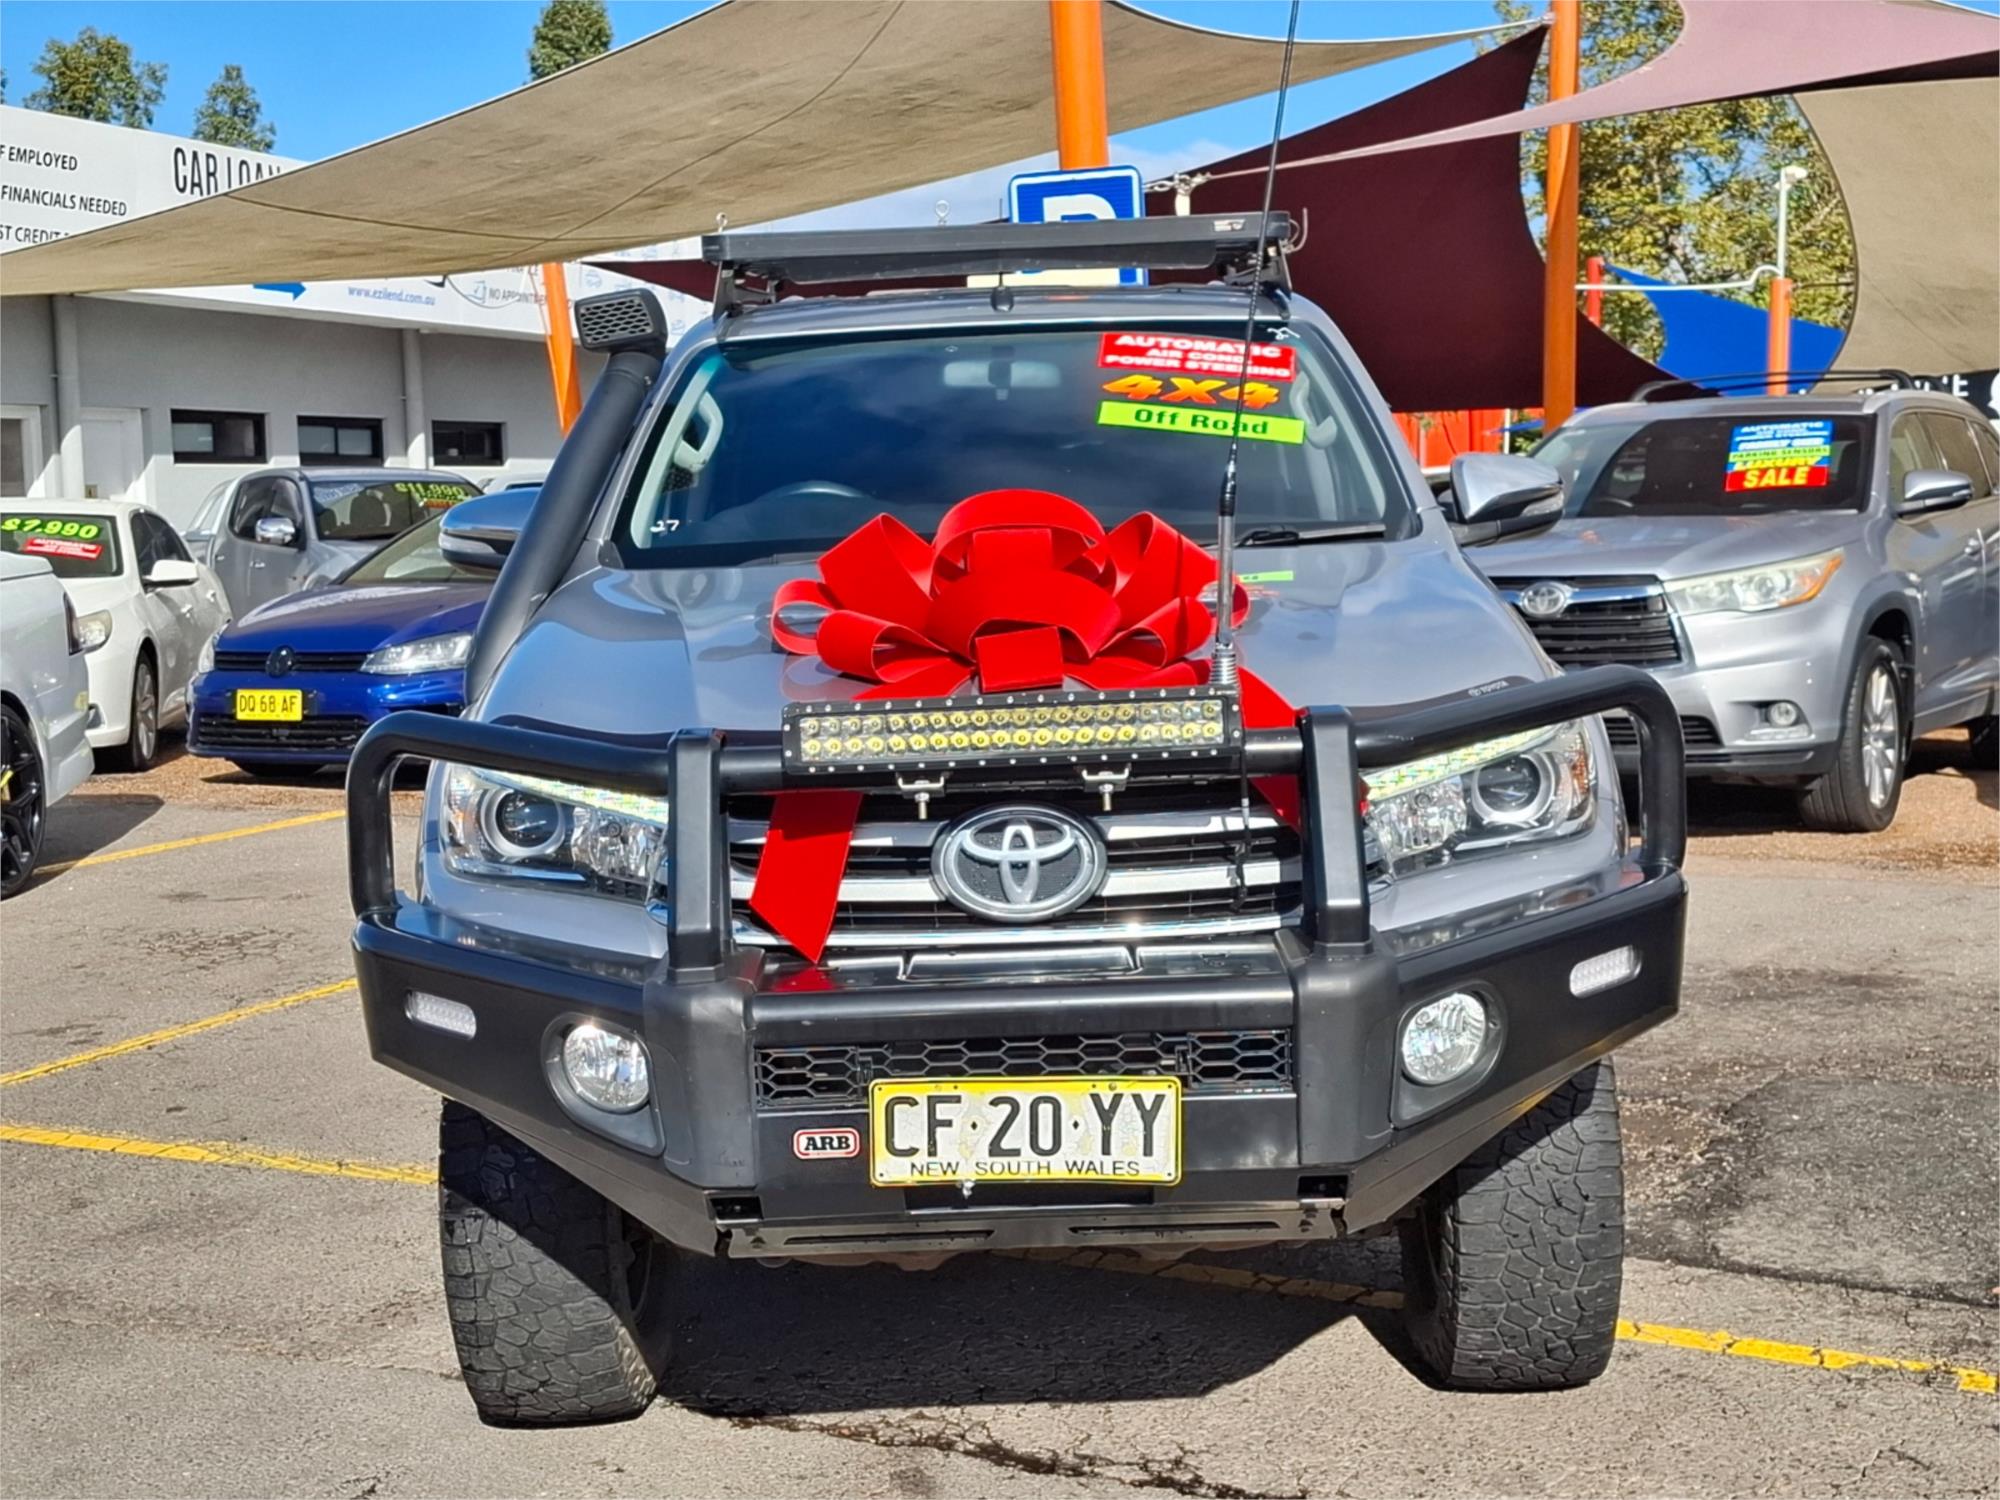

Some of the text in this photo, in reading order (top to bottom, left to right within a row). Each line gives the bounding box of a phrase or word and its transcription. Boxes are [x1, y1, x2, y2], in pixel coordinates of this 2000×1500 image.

[8, 146, 78, 171] EMPLOYED
[174, 147, 219, 197] CAR
[1, 185, 128, 216] FINANCIALS NEEDED
[1114, 335, 1282, 358] AUTOMATIC
[1146, 348, 1183, 359] AIR
[1105, 354, 1181, 369] POWER
[1102, 374, 1280, 410] 4X4
[1134, 408, 1268, 435] Off Road
[1742, 465, 1811, 489] SALE
[281, 695, 298, 713] AF
[884, 1093, 1166, 1158] CF 20 YY
[804, 1135, 851, 1151] ARB
[910, 1160, 1140, 1177] NEW SOUTH WALES
